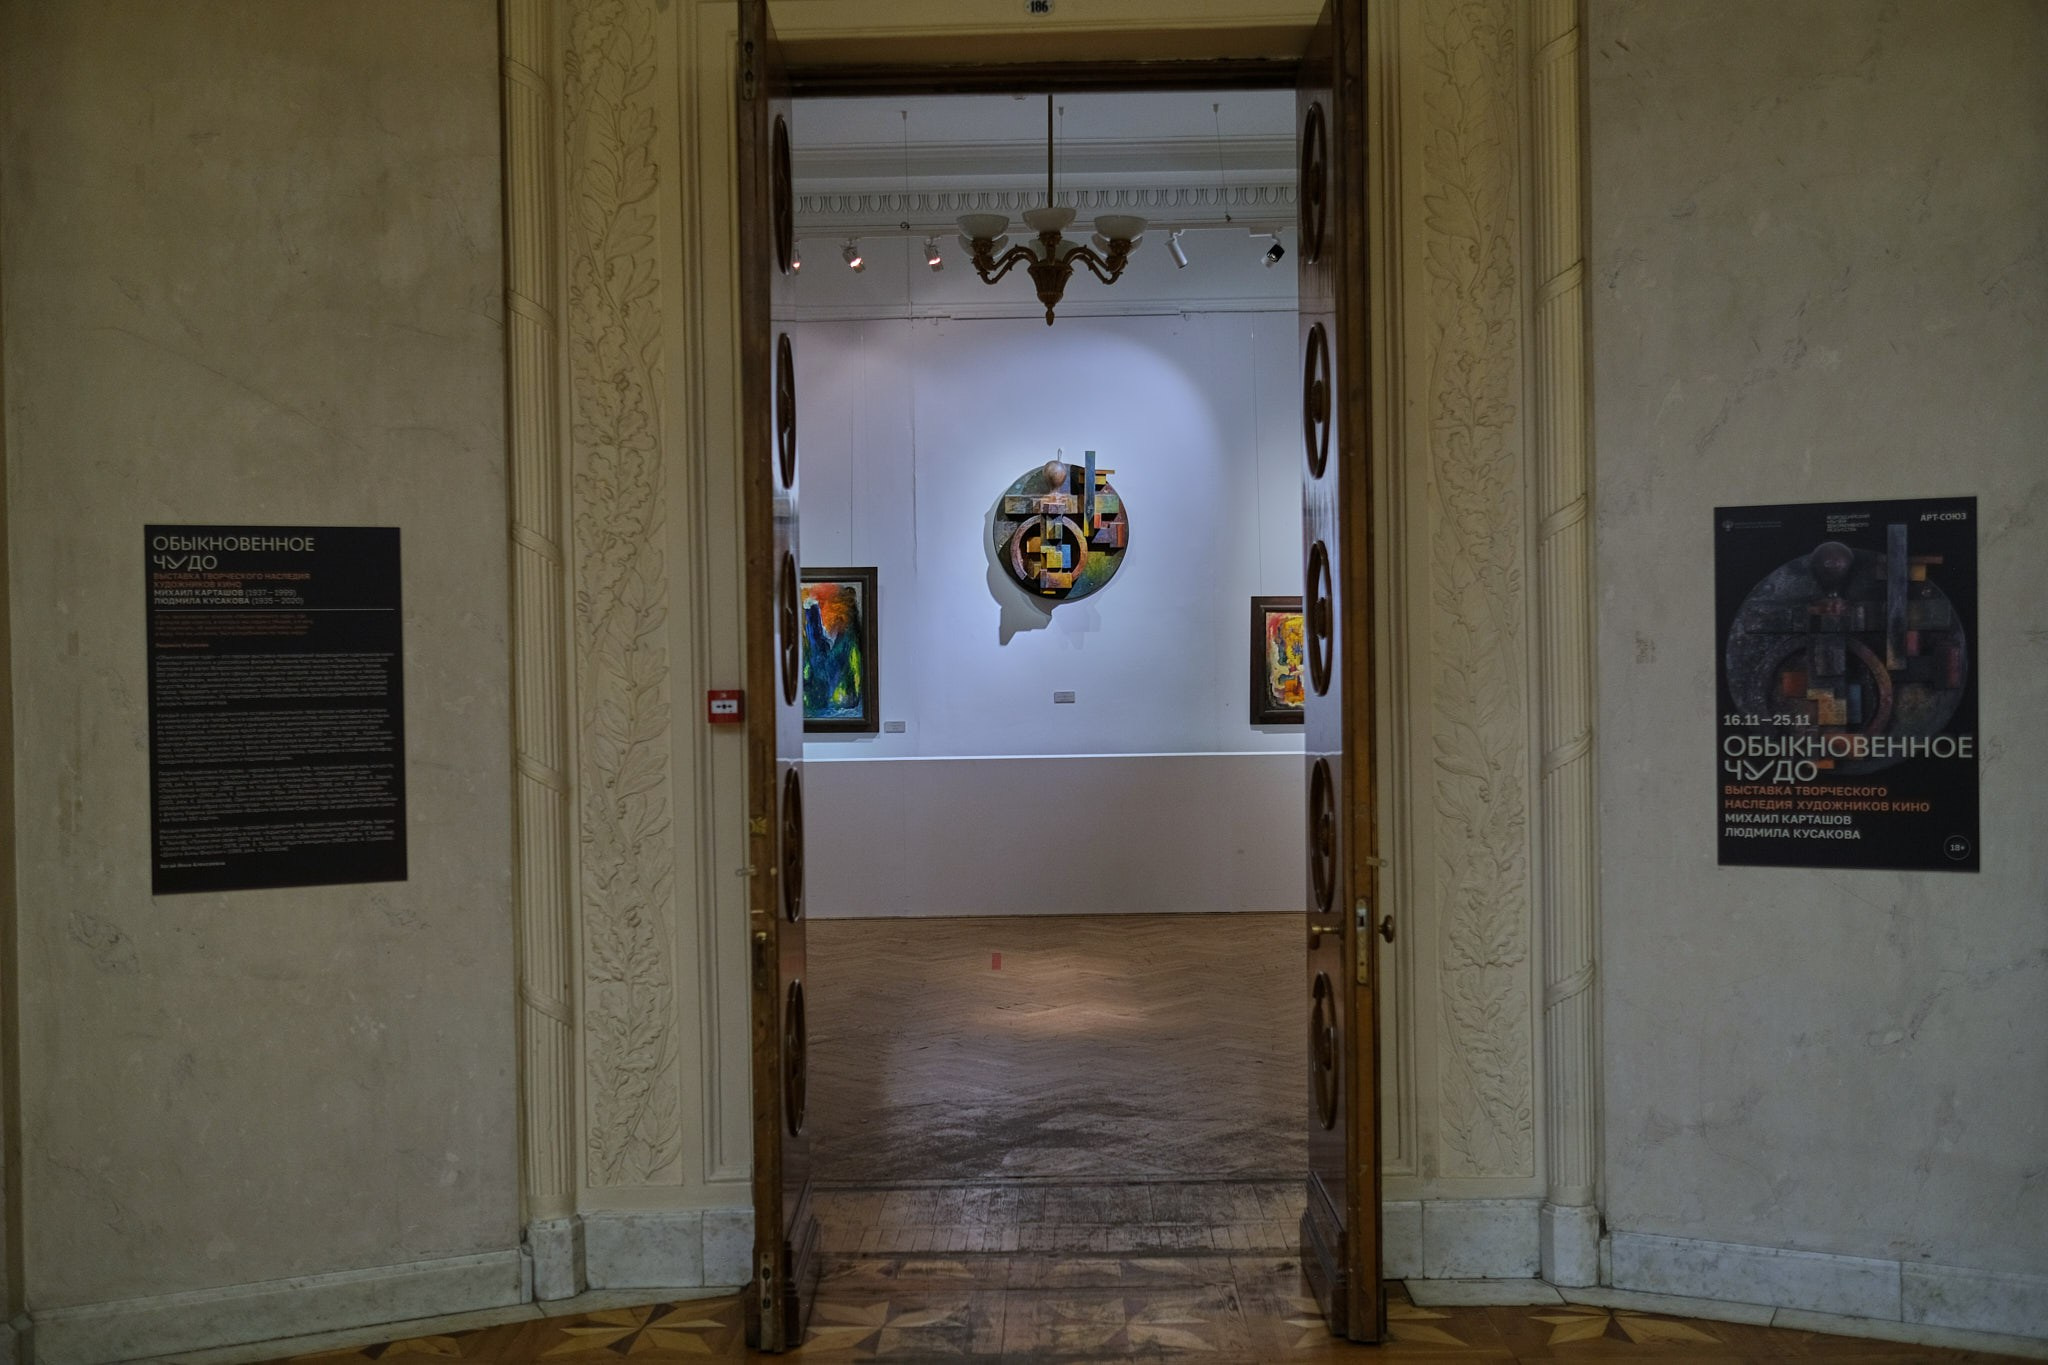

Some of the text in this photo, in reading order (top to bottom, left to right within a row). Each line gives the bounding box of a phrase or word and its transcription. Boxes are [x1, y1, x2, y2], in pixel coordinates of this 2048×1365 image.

[1030, 0, 1048, 13] 186
[1920, 513, 1966, 521] АРТ-СОЮЗ
[153, 536, 315, 552] ОБЫКНОВЕННОЕ
[154, 555, 218, 572] ЧУДО
[154, 597, 201, 605] ЛЮДМИЛА
[203, 597, 250, 605] КУСАКОВА
[1724, 735, 1973, 758] ОБЫКНОВЕННОЕ
[1724, 760, 1818, 784] ЧУДО
[1725, 785, 1887, 797] ВЫСТАВКА ТВОРЧЕСКОГО
[1725, 800, 1930, 812] НАСЛЕДИЯ ХУДОЖНИКОВ КИНО
[1725, 814, 1852, 825] МИХАИЛ КАРТАШОВ
[1724, 828, 1861, 840] ЛЮДМИЛА КУСАКОВА
[1950, 844, 1965, 852] 18+
